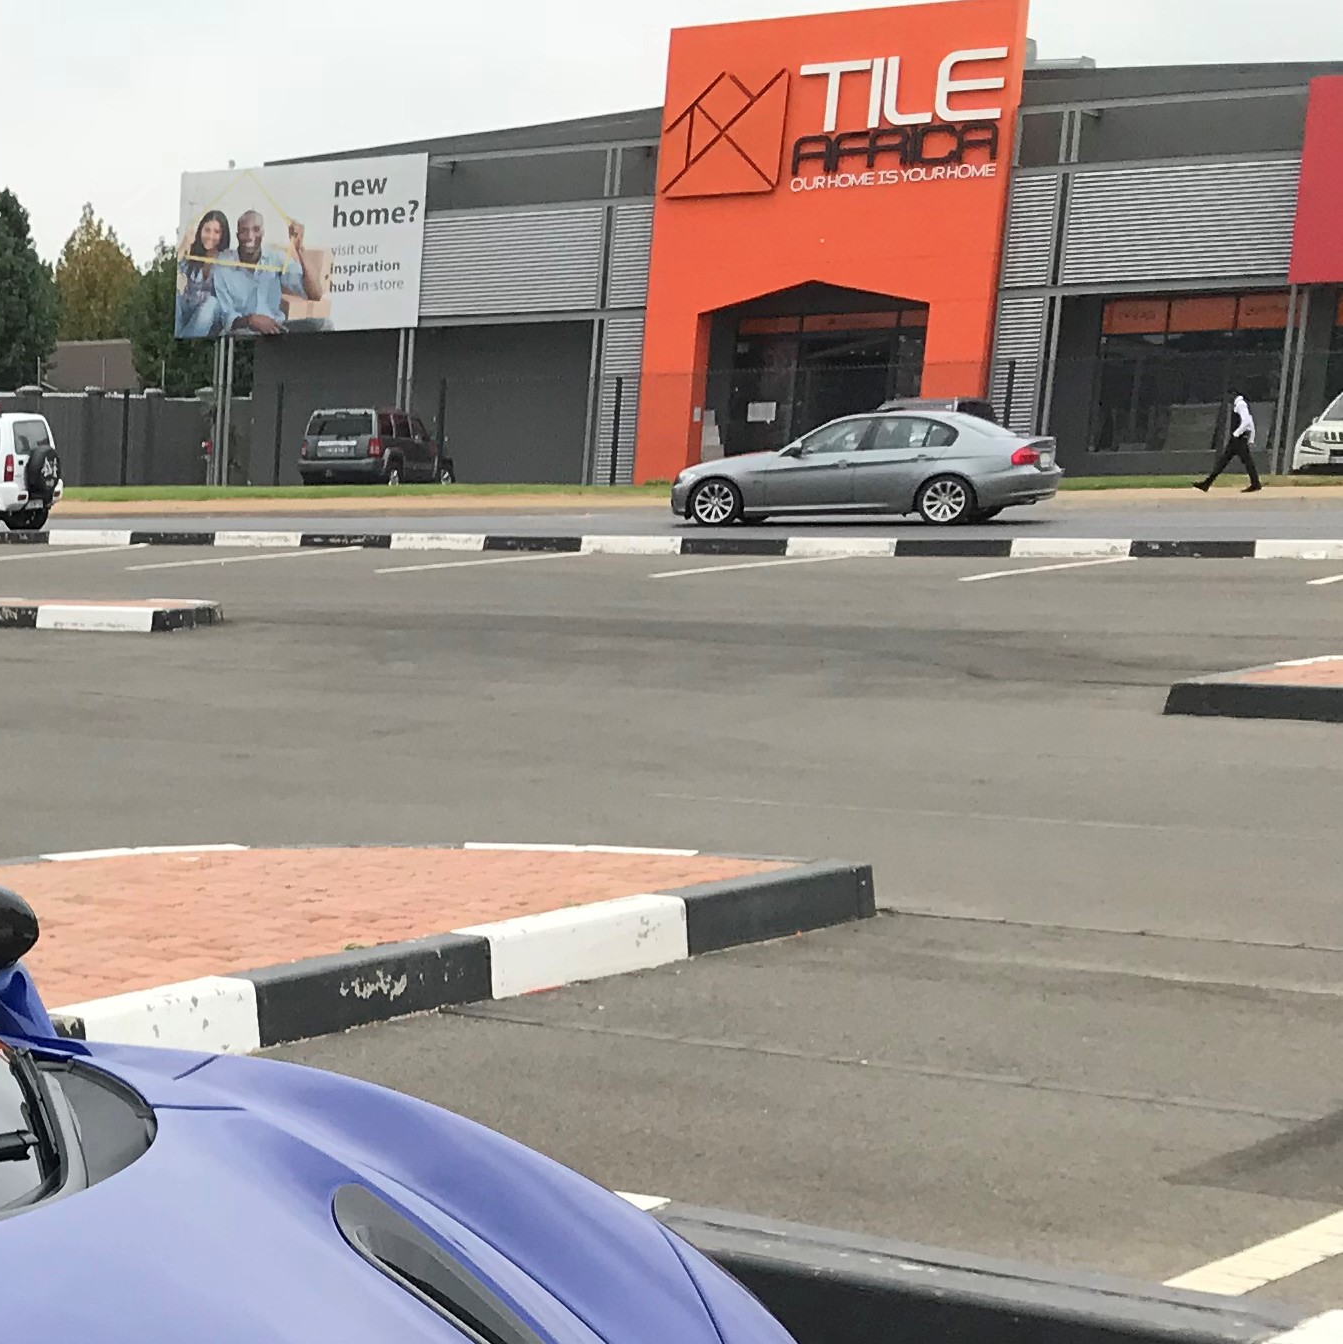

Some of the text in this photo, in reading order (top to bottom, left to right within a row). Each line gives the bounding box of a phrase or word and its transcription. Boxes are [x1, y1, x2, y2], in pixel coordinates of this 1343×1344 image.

[799, 46, 1009, 133] TILE
[791, 121, 999, 176] AFRICA
[334, 176, 388, 198] new
[790, 162, 997, 192] OUR HOME IS YOUR HOME
[332, 199, 420, 228] home?
[331, 243, 378, 256] visit our
[330, 259, 401, 276] inspiration
[329, 279, 404, 293] hub in-store
